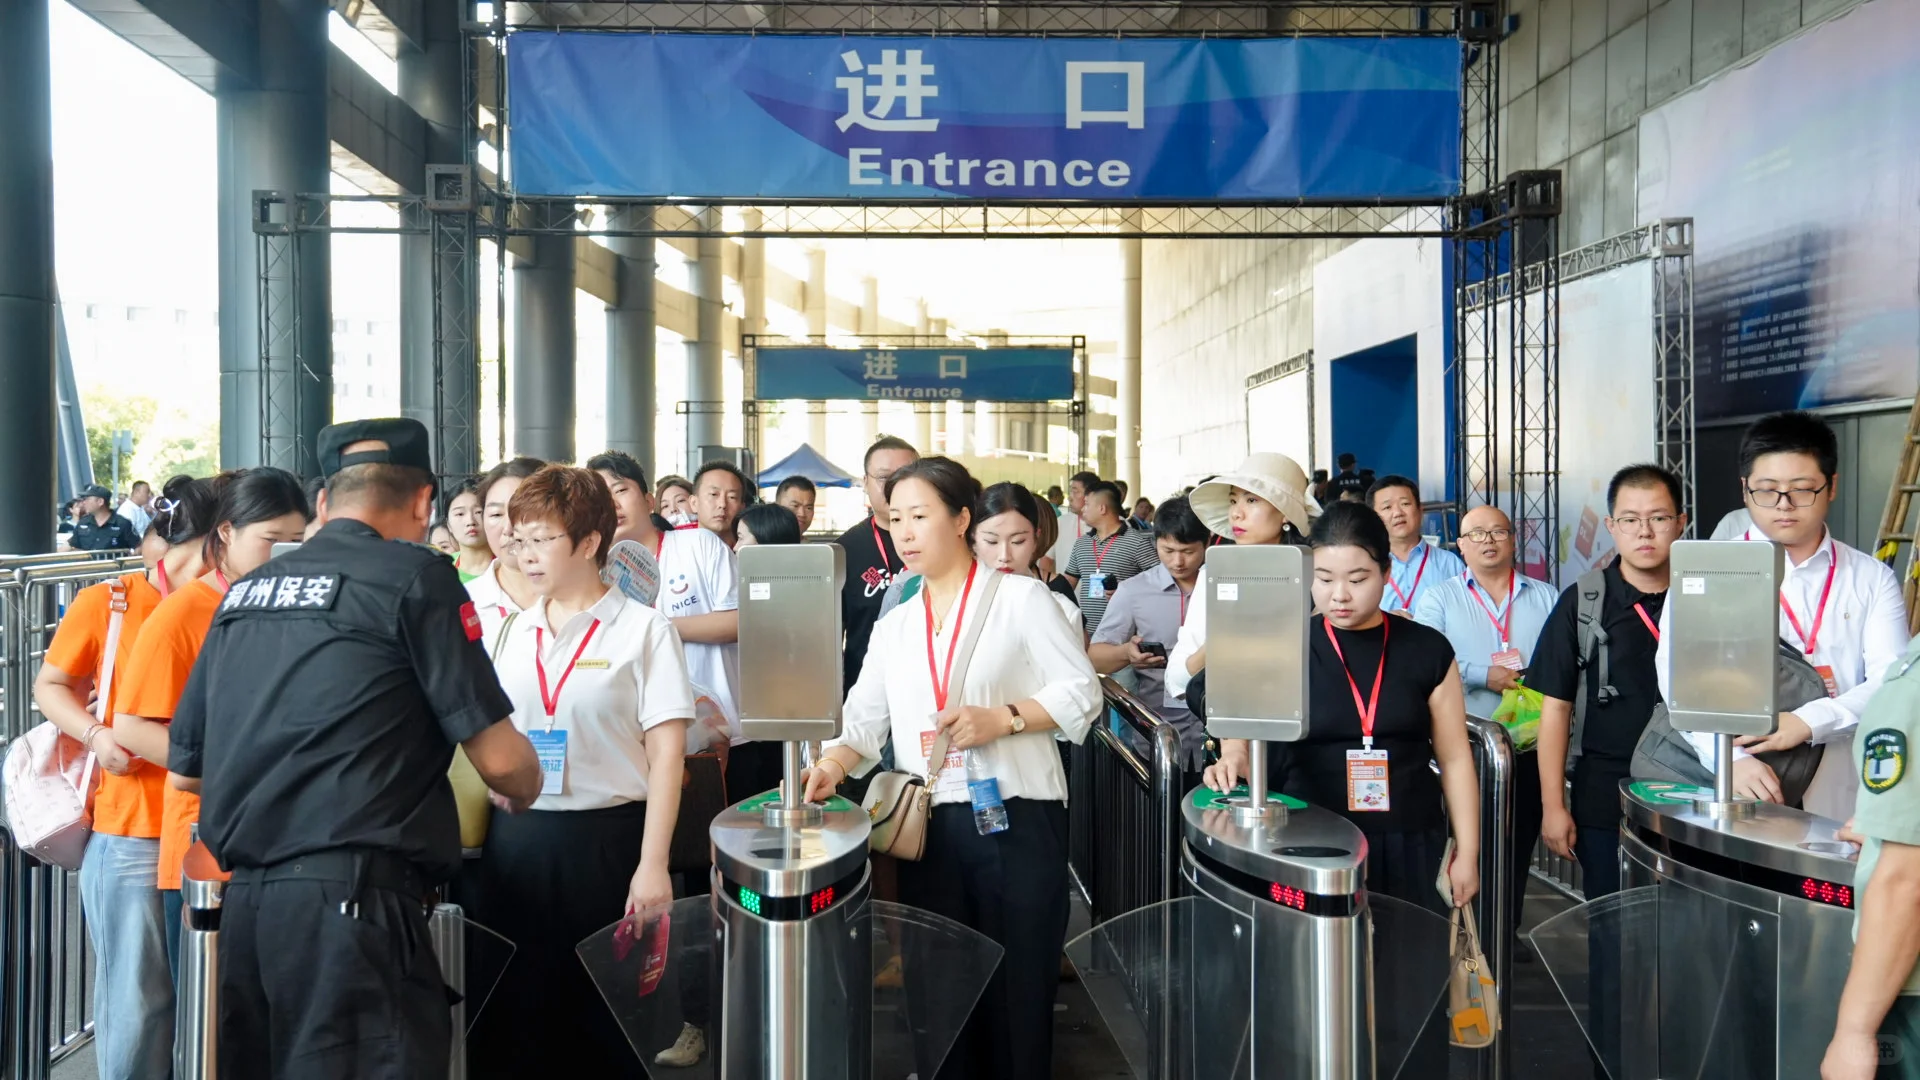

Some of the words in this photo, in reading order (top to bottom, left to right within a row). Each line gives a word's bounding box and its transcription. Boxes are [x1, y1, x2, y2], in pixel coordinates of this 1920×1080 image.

[848, 147, 1132, 187] Entrance
[866, 383, 963, 399] Entrance
[222, 575, 334, 612] 稠州保安
[671, 595, 698, 612] NICE
